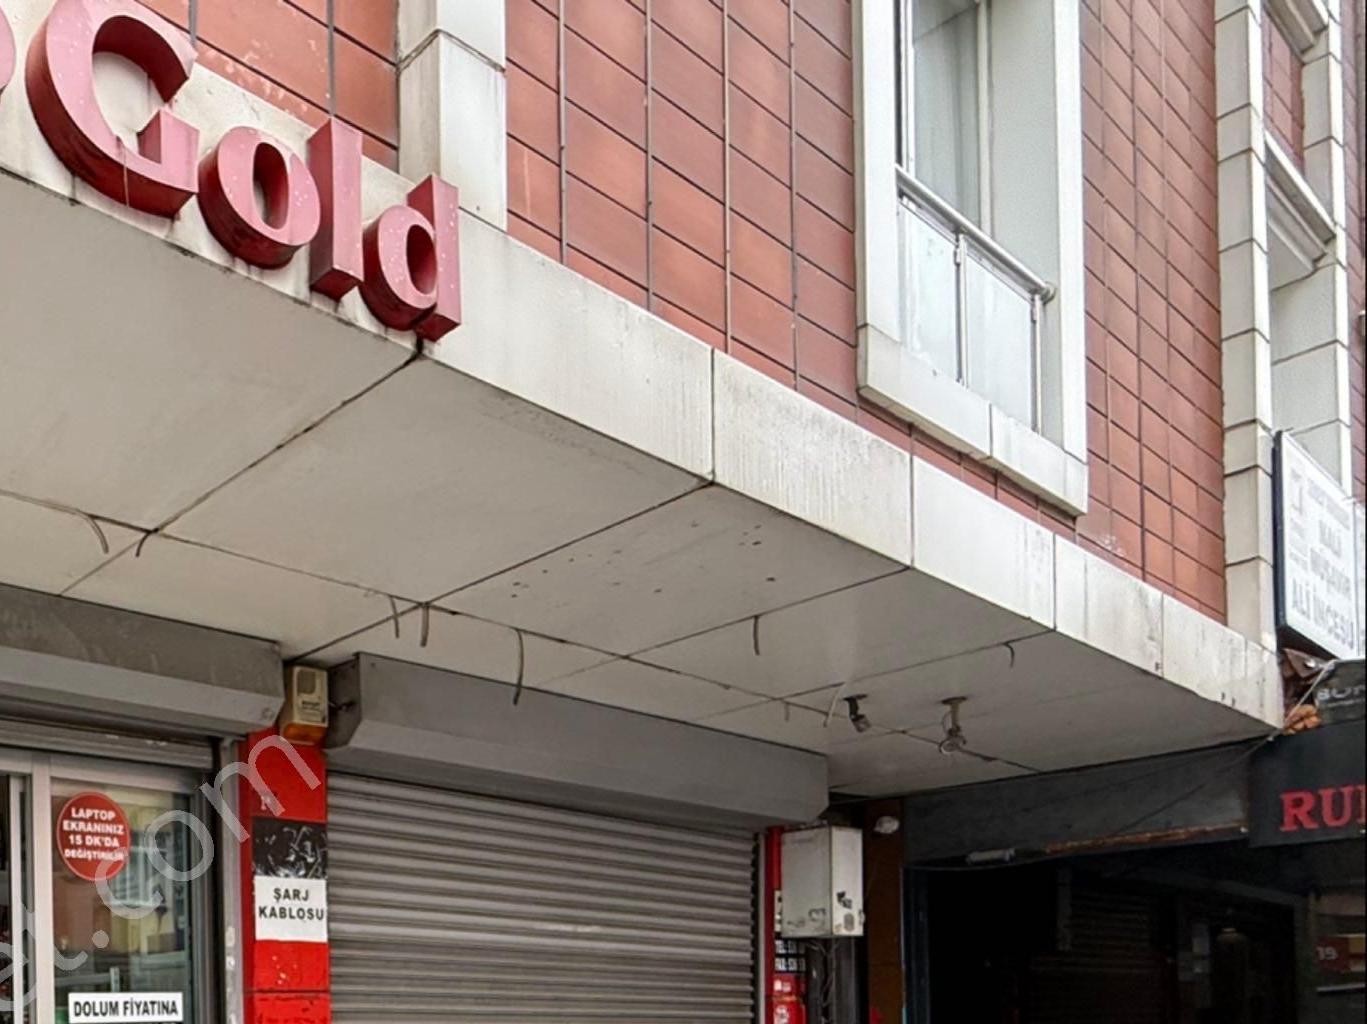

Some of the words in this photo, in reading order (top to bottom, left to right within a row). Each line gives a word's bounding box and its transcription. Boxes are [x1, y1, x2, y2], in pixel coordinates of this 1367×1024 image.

[71, 807, 116, 821] LAPTOP
[62, 820, 124, 835] EKRANINIZ
[68, 834, 83, 845] 15
[273, 887, 310, 902] ŞARJ
[258, 906, 325, 921] KABLOSU
[74, 1000, 119, 1017] DOLUM
[123, 998, 178, 1016] FİYATINA
